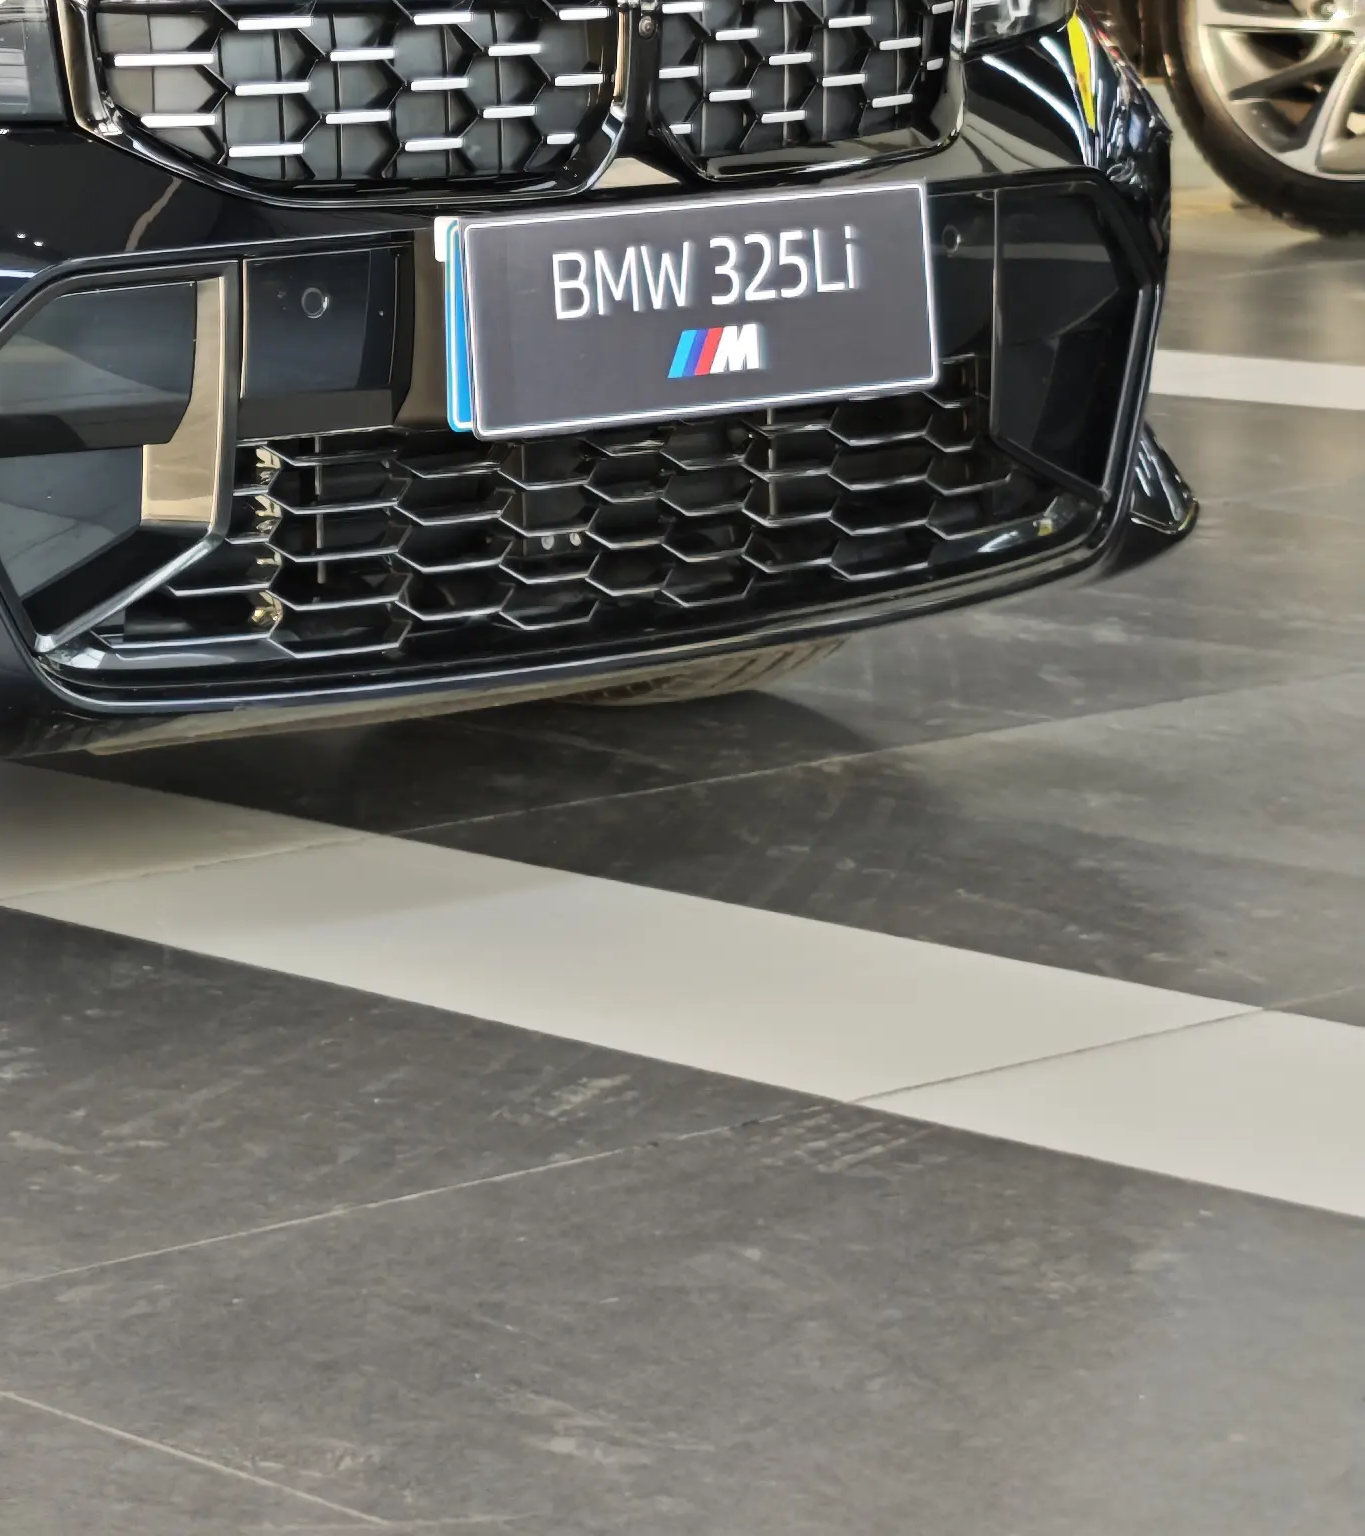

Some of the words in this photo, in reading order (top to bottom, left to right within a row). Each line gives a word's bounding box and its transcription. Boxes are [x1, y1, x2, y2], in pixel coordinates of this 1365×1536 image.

[552, 241, 692, 320] BMW
[709, 225, 857, 306] 325Li
[709, 323, 762, 375] M
